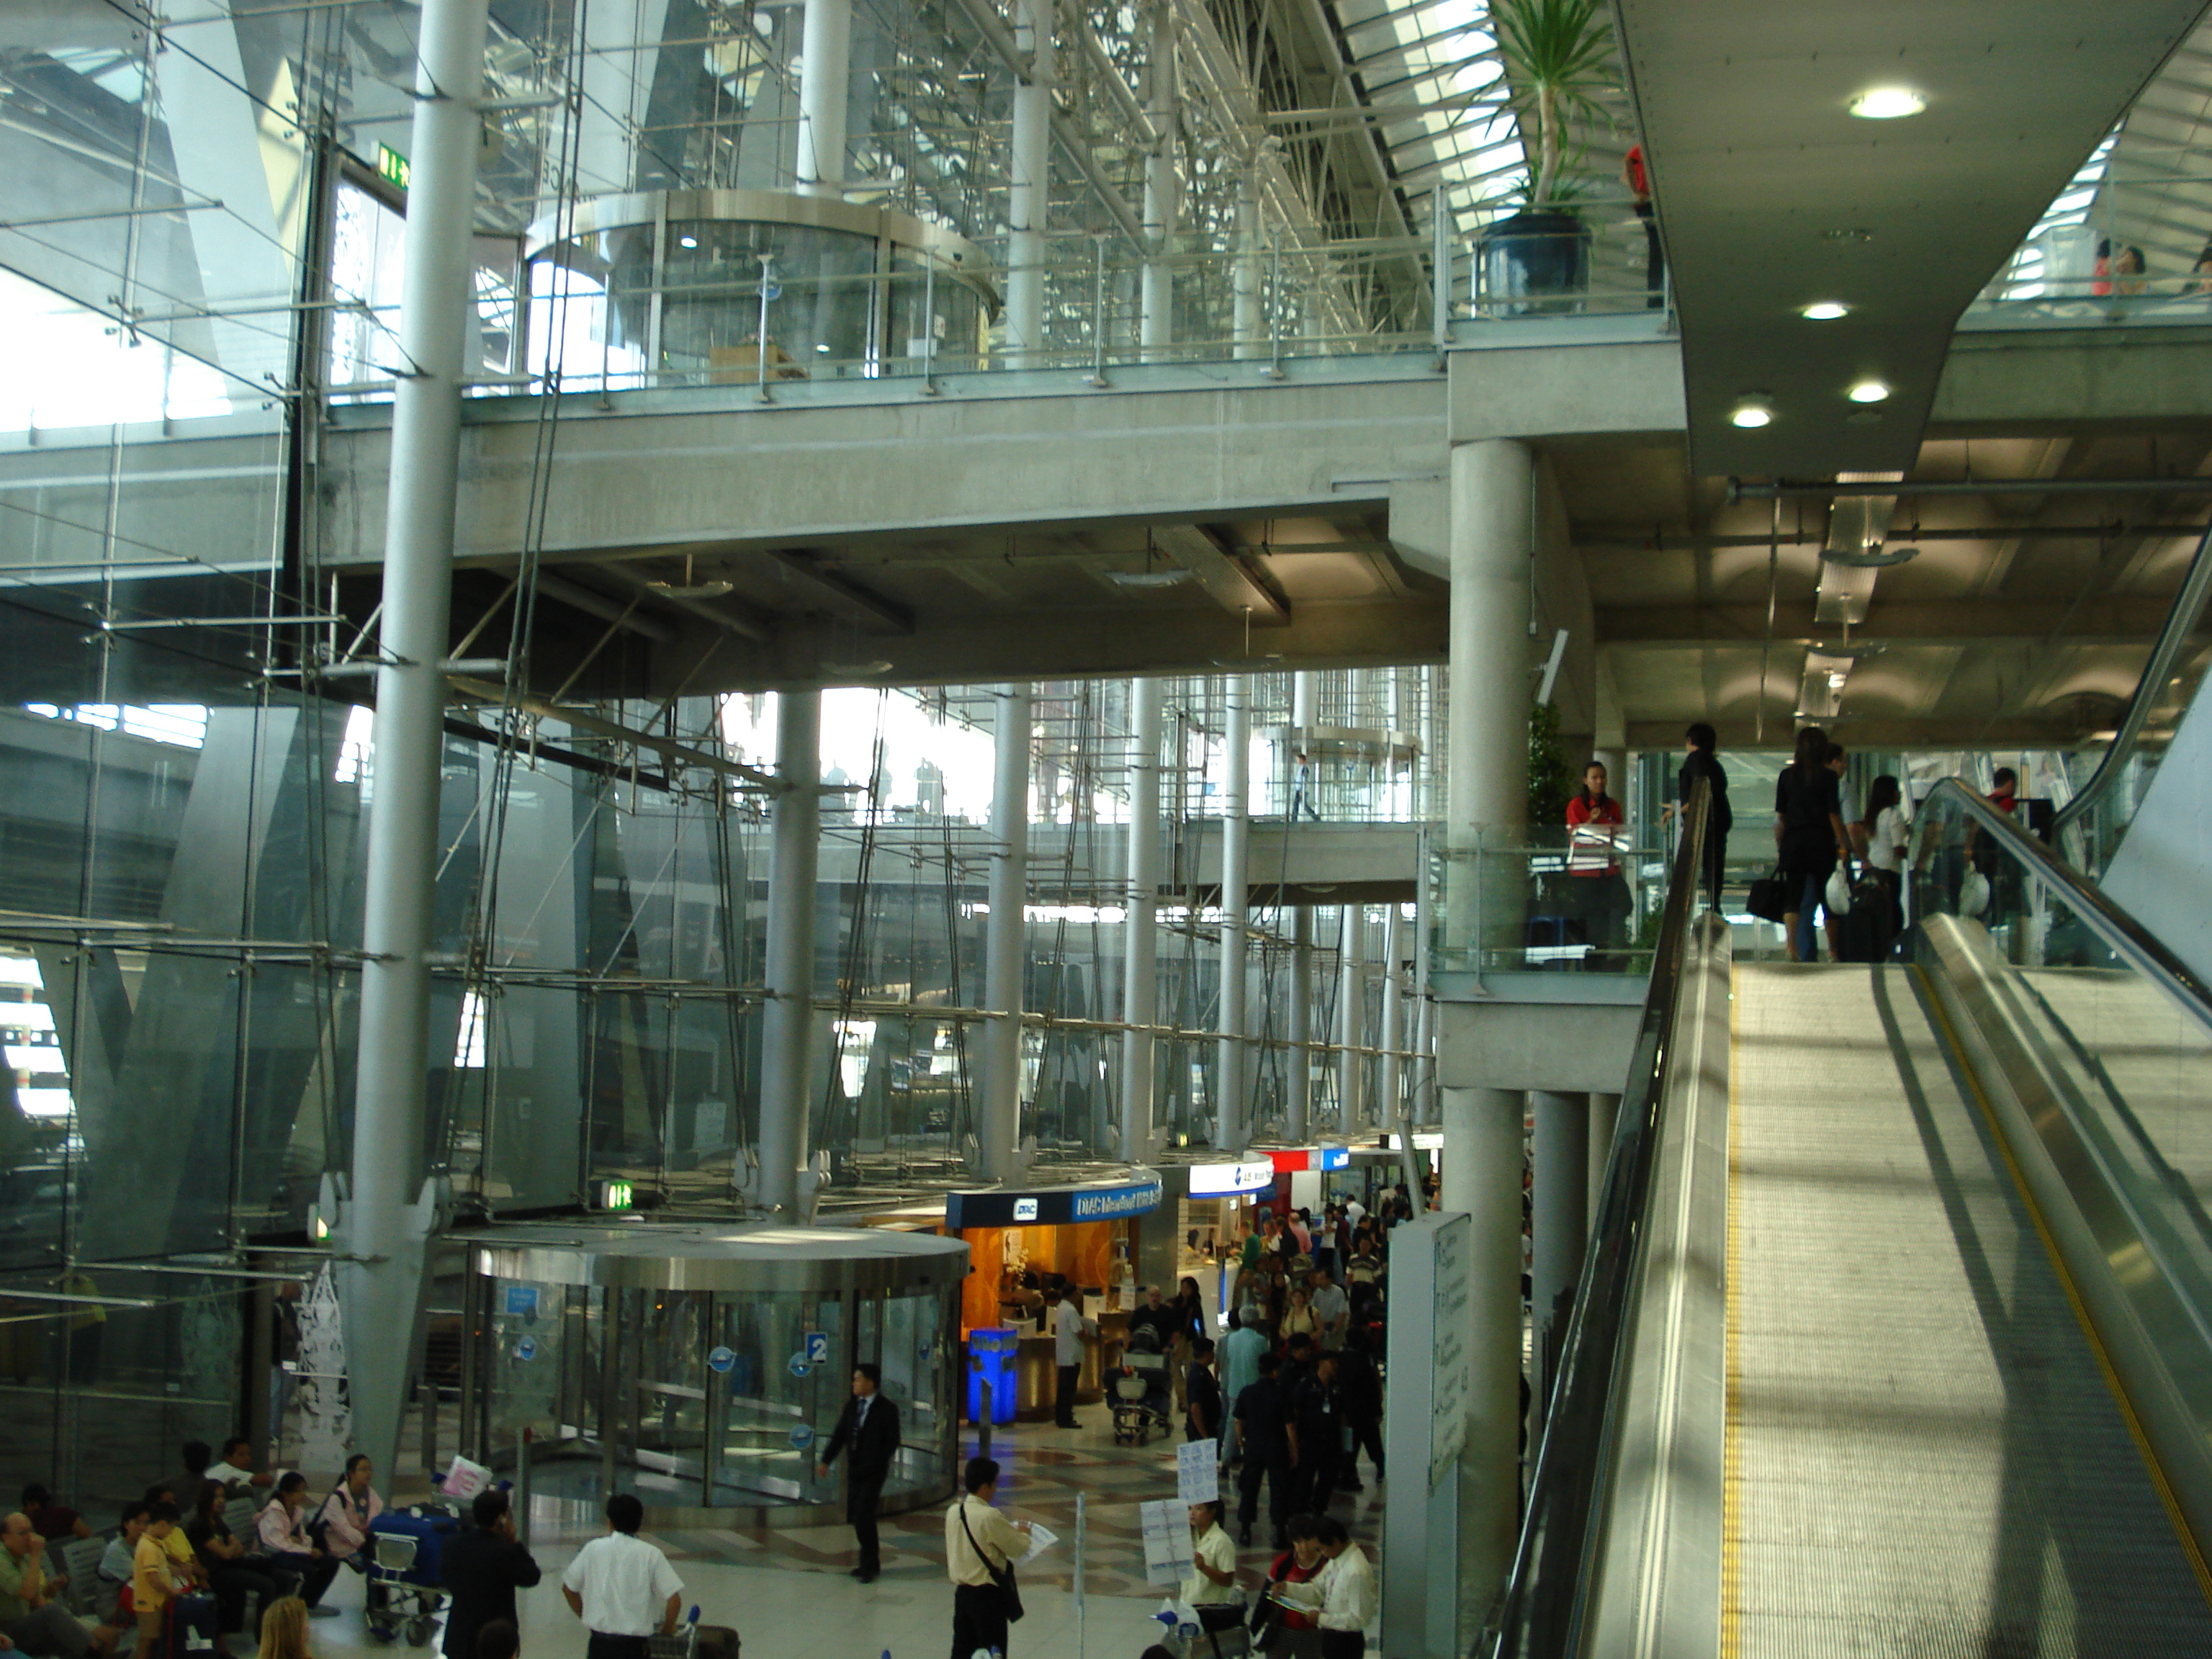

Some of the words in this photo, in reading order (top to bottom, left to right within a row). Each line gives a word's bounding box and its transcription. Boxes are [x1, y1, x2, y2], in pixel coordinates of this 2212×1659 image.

[1017, 1205, 1036, 1215] DTAC
[1077, 1197, 1101, 1215] DTAC
[812, 1338, 827, 1360] 2
